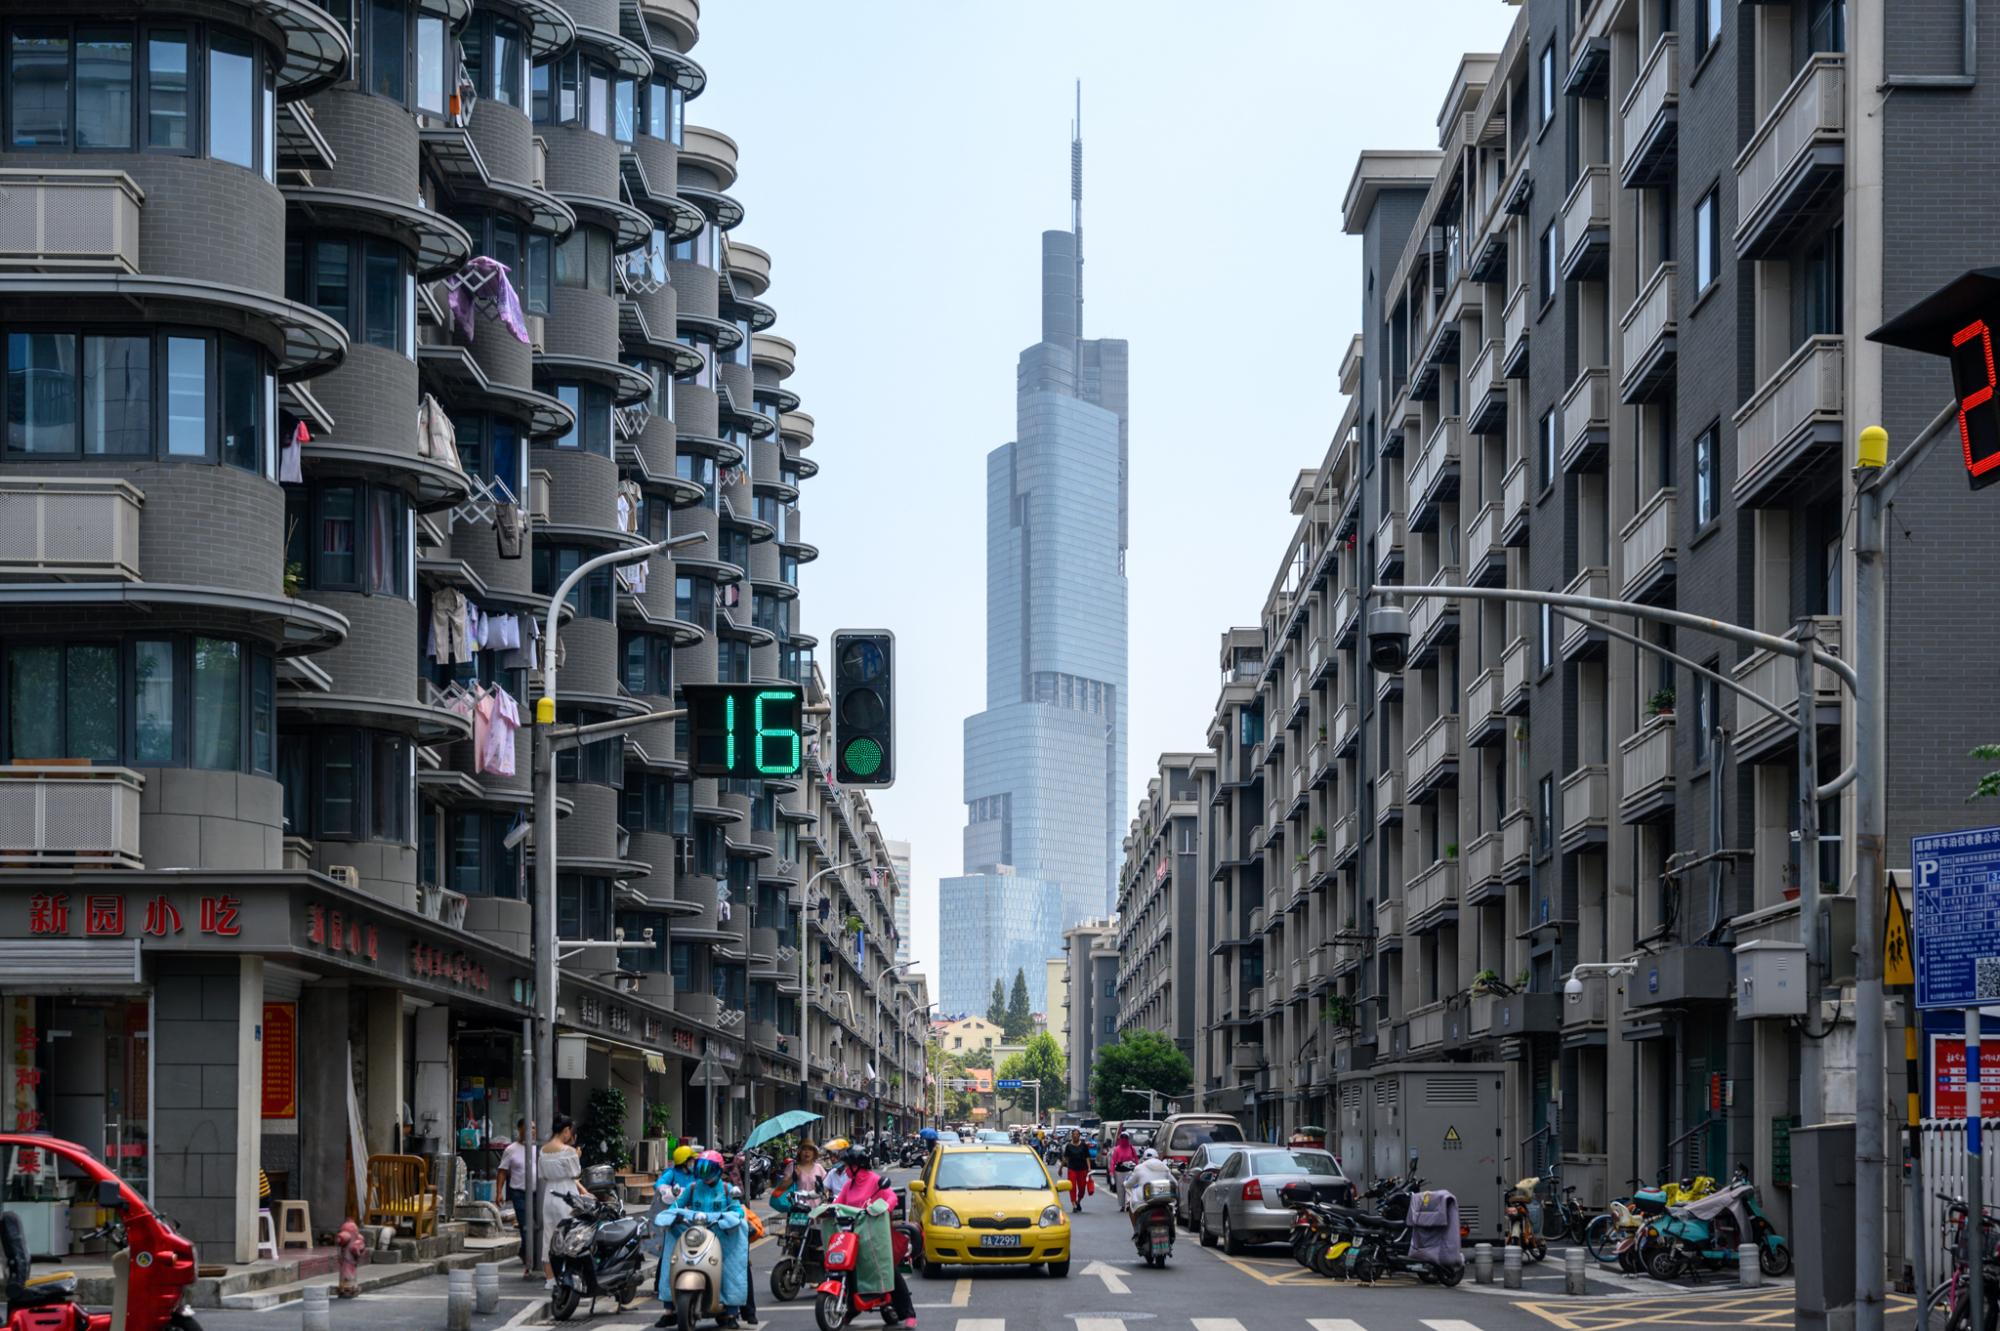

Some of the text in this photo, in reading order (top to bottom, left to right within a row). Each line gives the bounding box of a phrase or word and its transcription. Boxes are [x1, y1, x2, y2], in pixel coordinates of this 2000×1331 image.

[726, 690, 799, 774] 16
[1918, 860, 1939, 888] P
[29, 892, 241, 937] 新园小吃
